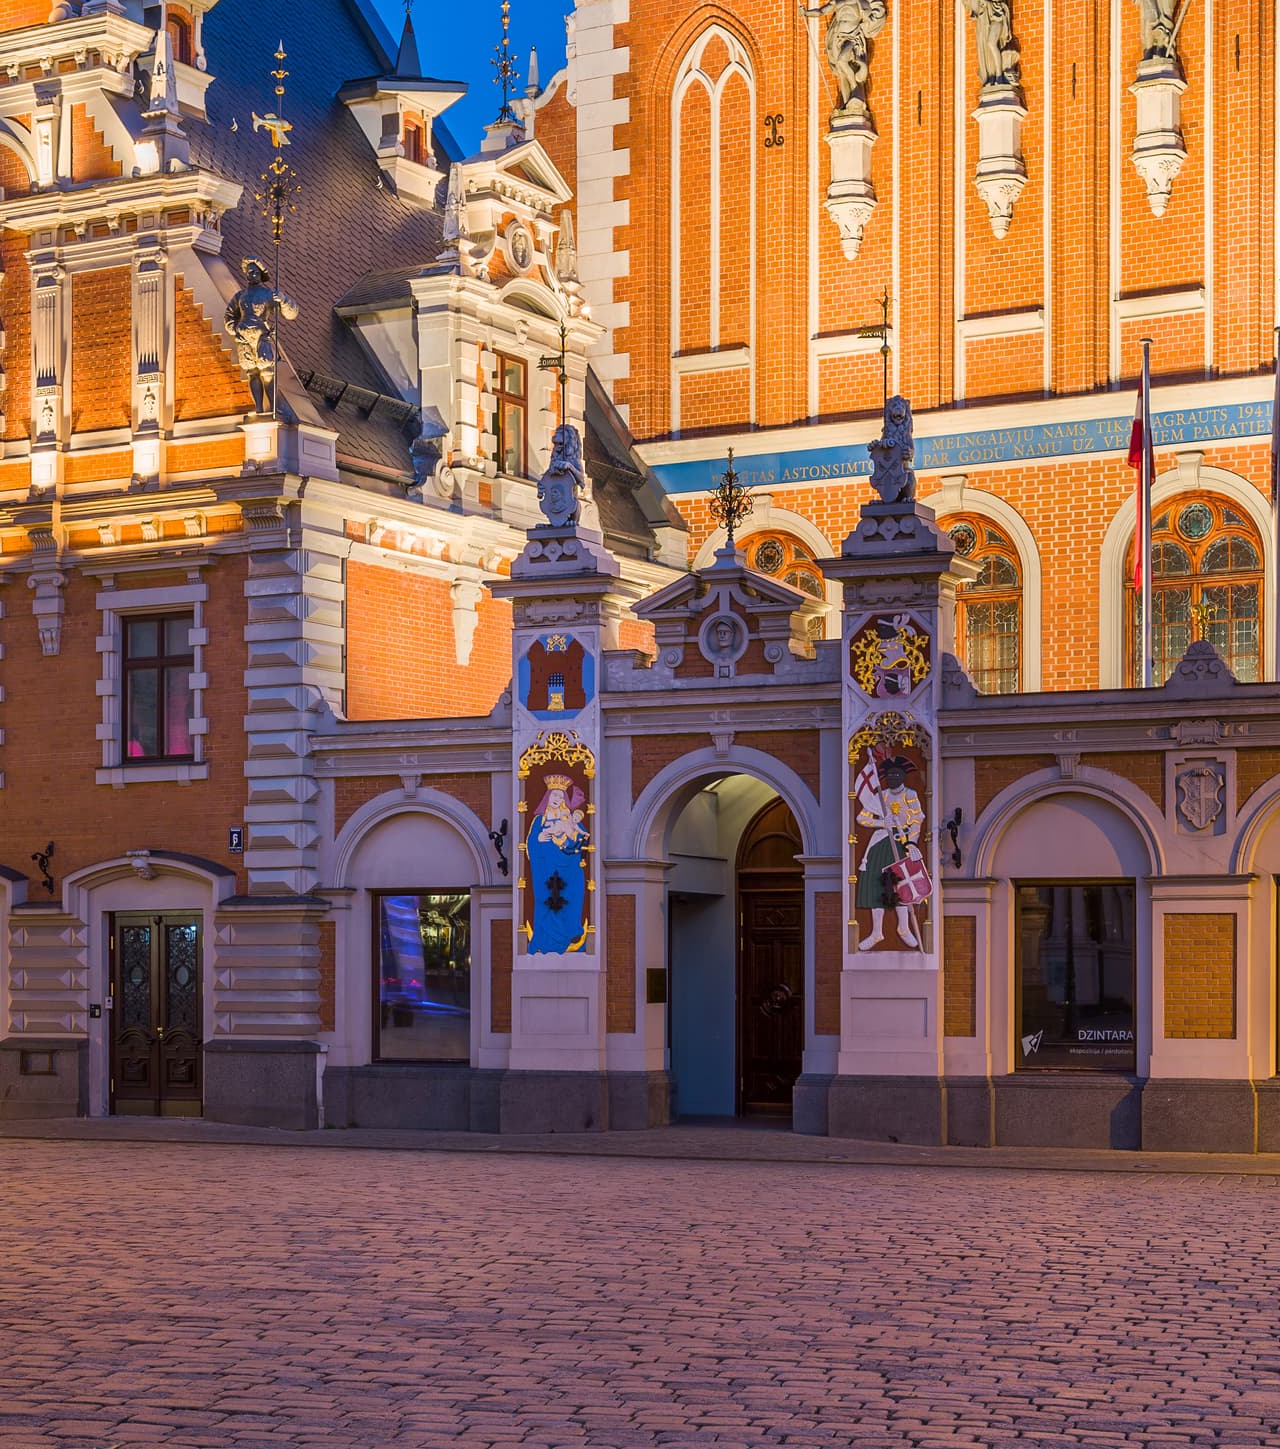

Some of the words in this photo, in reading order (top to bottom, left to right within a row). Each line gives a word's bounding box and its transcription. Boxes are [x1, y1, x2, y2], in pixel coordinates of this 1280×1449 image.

[923, 452, 950, 467] PAR
[958, 445, 1006, 463] GODU
[1013, 440, 1063, 458] NAMU
[1072, 437, 1095, 451] UZ
[1103, 429, 1184, 449] VECIEM
[931, 429, 1035, 451] MELNGALVJU
[1043, 424, 1087, 441] NAMS
[1096, 418, 1134, 434] TIKA
[1148, 408, 1228, 429] AGRAUTS
[1078, 1030, 1134, 1041] DZINTARA
